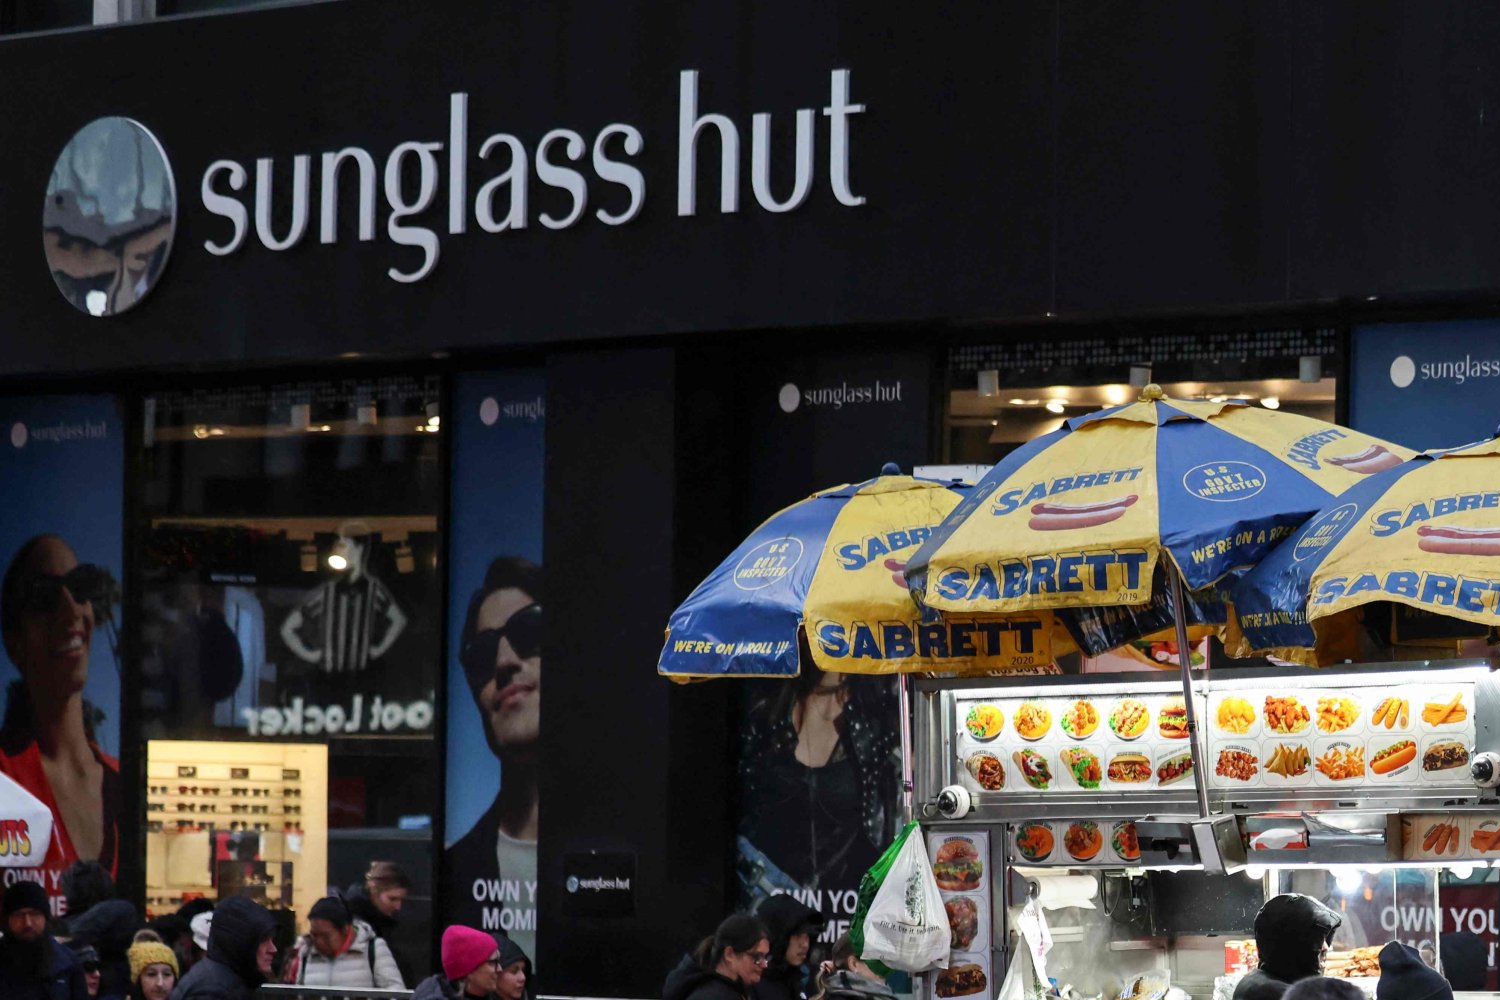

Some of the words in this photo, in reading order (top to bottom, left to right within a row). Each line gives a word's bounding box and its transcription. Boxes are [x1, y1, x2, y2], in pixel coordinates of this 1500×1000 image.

[202, 91, 646, 284] sunglass
[676, 68, 867, 217] hut
[1420, 354, 1500, 385] sunglass
[803, 381, 873, 410] sunglass
[991, 465, 1145, 517] SABRETT
[1198, 479, 1262, 497] INSPECTED
[1204, 473, 1244, 487] GOV'T
[1191, 537, 1233, 565] WE'RE
[1235, 531, 1252, 546] ON
[1256, 529, 1266, 544] A
[934, 548, 1150, 600] SABRETT
[1116, 592, 1138, 602] 2019
[673, 640, 713, 654] WE'RE
[715, 641, 735, 655] ON
[743, 641, 773, 655] ROLL
[814, 617, 1042, 660] SABRETT
[1011, 656, 1034, 666] 2020
[472, 878, 520, 903] OWN
[579, 876, 616, 892] sunglass
[616, 876, 630, 891] hut
[482, 905, 537, 931] MOM
[1380, 905, 1444, 933] OWN
